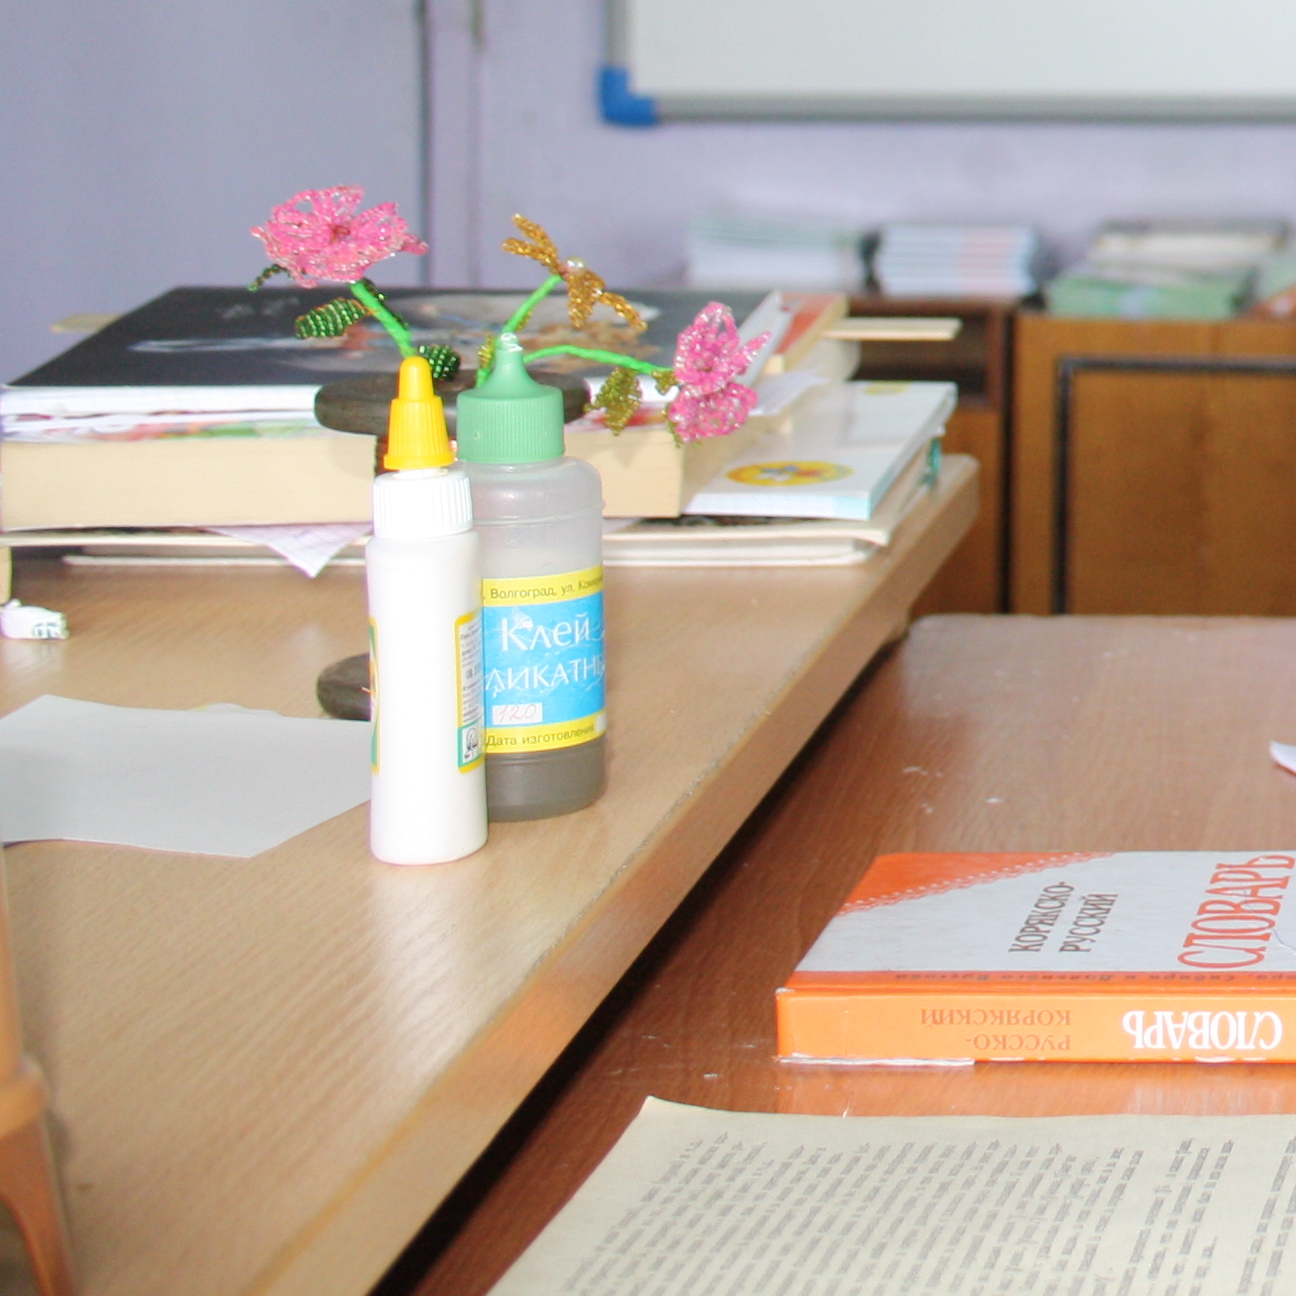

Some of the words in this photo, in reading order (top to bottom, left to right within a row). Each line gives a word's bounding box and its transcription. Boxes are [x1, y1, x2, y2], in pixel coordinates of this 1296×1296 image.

[490, 587, 558, 600] Волгоград,
[501, 612, 591, 651] Клей
[499, 704, 538, 723] 120
[487, 734, 518, 747] Дата
[1008, 880, 1075, 954] КОРЯКСКО-
[1059, 892, 1119, 954] РУССКИЙ
[1177, 854, 1296, 969] СЛОВАРЬ
[919, 1008, 1071, 1030] КОРЯКСКИЙ
[1122, 1010, 1283, 1051] СЛОВАРЬ
[965, 1034, 1071, 1052] РУССКО-
